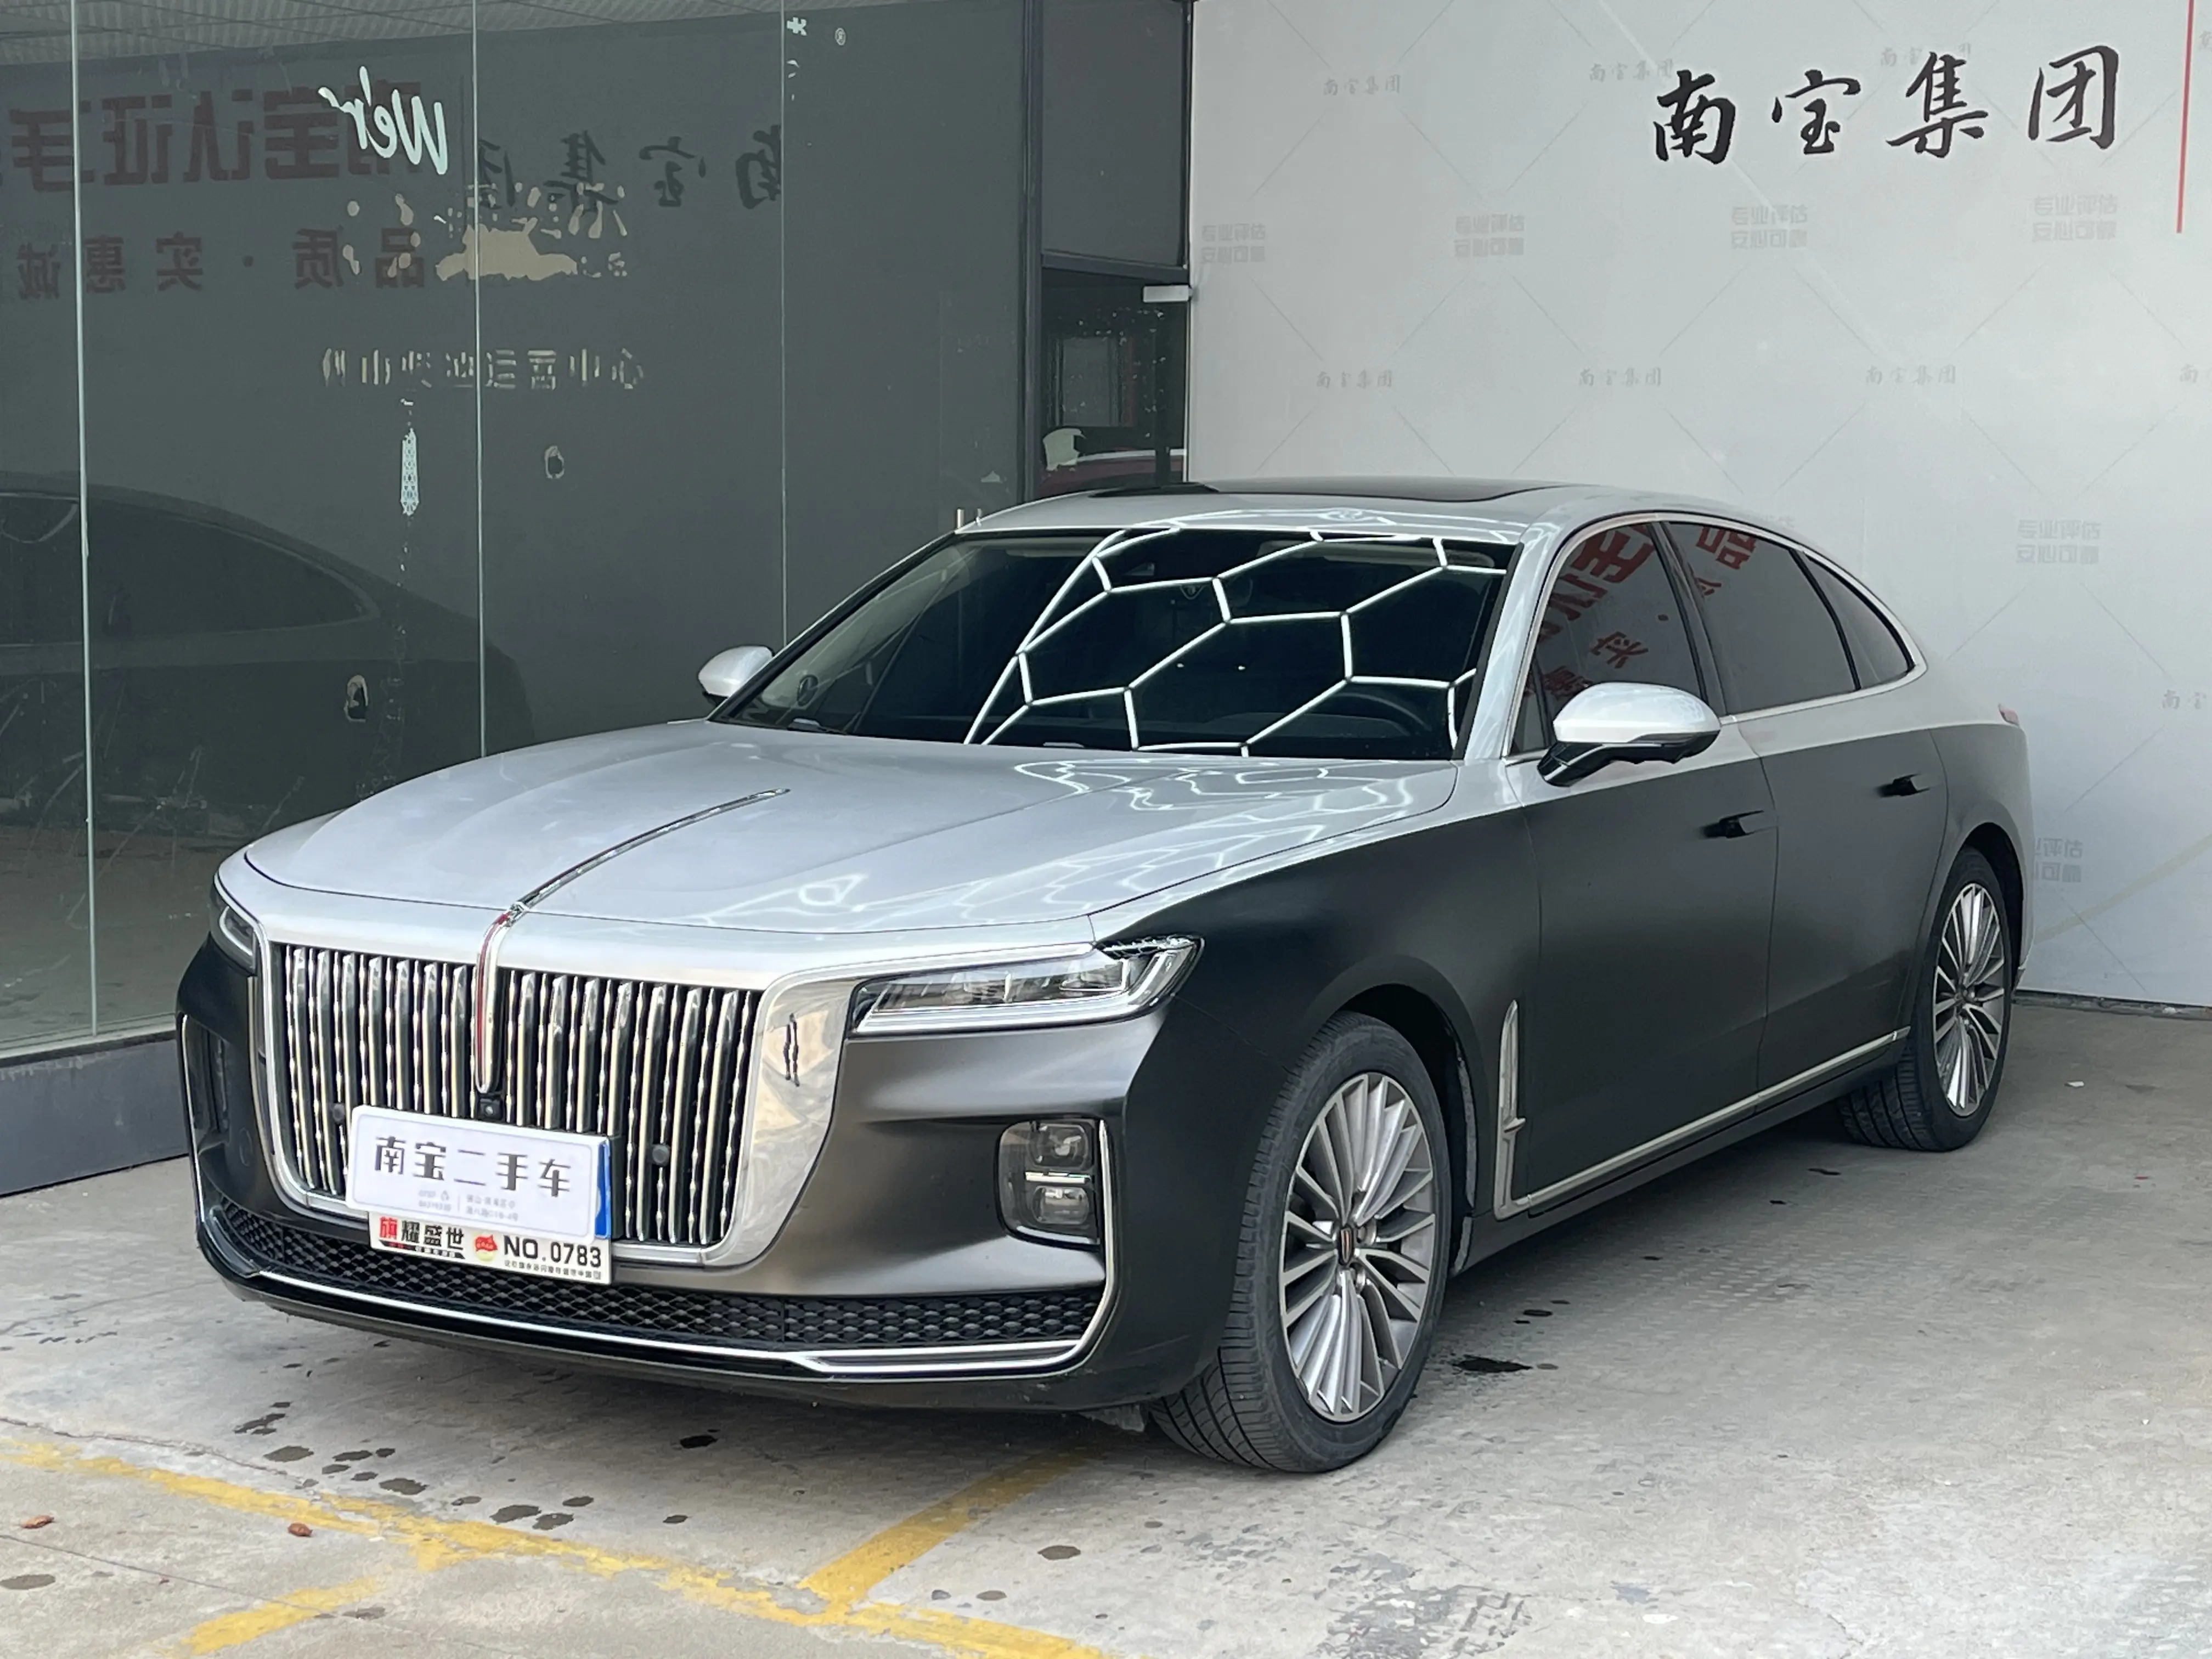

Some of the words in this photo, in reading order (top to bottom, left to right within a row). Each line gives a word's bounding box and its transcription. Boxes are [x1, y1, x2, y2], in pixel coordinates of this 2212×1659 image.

[1323, 74, 1401, 95] 南宝集团
[1652, 44, 2120, 166] 南宝集团
[1318, 369, 1392, 388] 南宝集团
[1580, 367, 1662, 387] 南宝集团
[1865, 364, 1956, 385] 南宝集团
[375, 1136, 571, 1198] 南宝二手车
[379, 1216, 465, 1251] 旗耀盛世
[504, 1235, 601, 1268] NO.0783
